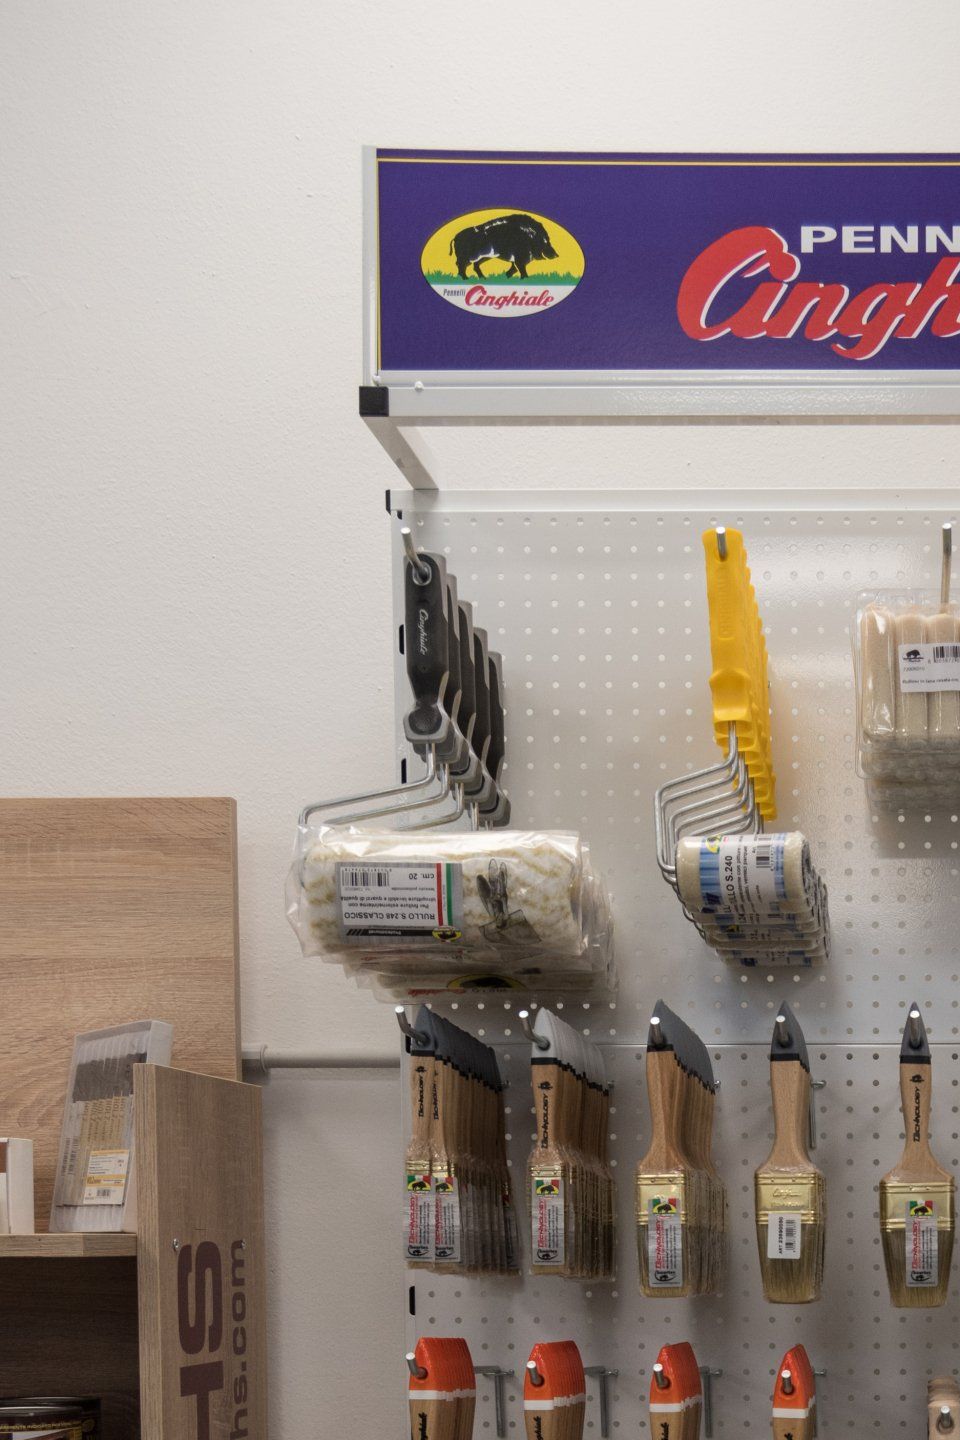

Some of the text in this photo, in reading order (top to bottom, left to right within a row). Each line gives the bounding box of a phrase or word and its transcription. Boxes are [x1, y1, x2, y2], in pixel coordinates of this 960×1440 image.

[443, 285, 555, 310] Pennelli Cinghiale
[418, 608, 428, 656] Cinghiale
[724, 855, 734, 882] S.240
[344, 911, 384, 921] CLASSICO
[408, 912, 435, 921] RULLO
[913, 1086, 921, 1142] TECHNOLOGY
